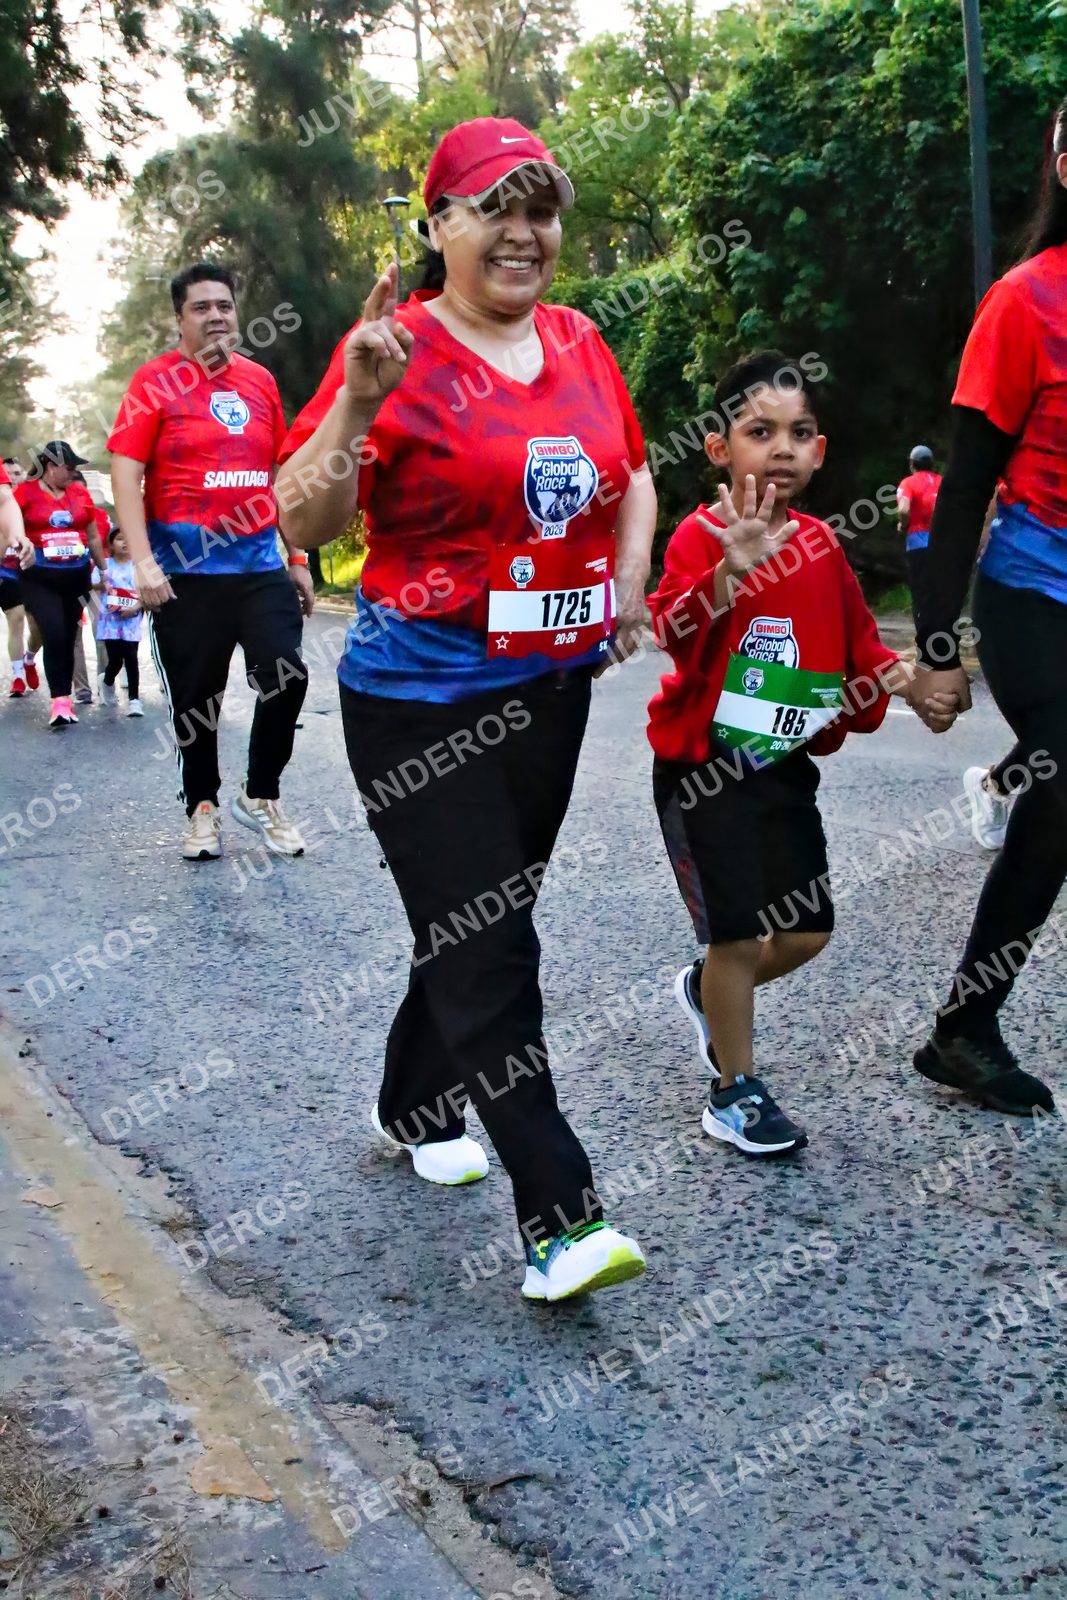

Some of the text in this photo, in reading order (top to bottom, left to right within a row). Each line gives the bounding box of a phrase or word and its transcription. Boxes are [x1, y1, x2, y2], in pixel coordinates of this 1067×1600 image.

[535, 445, 576, 456] BIMBO
[542, 460, 579, 477] Global
[203, 470, 269, 488] SANTIAGO
[535, 476, 567, 491] Race
[544, 524, 564, 537] 2026
[541, 589, 591, 628] 1725
[755, 624, 787, 634] BIMBO
[755, 638, 786, 652] Global
[748, 649, 775, 662] Race
[772, 706, 810, 736] 185
